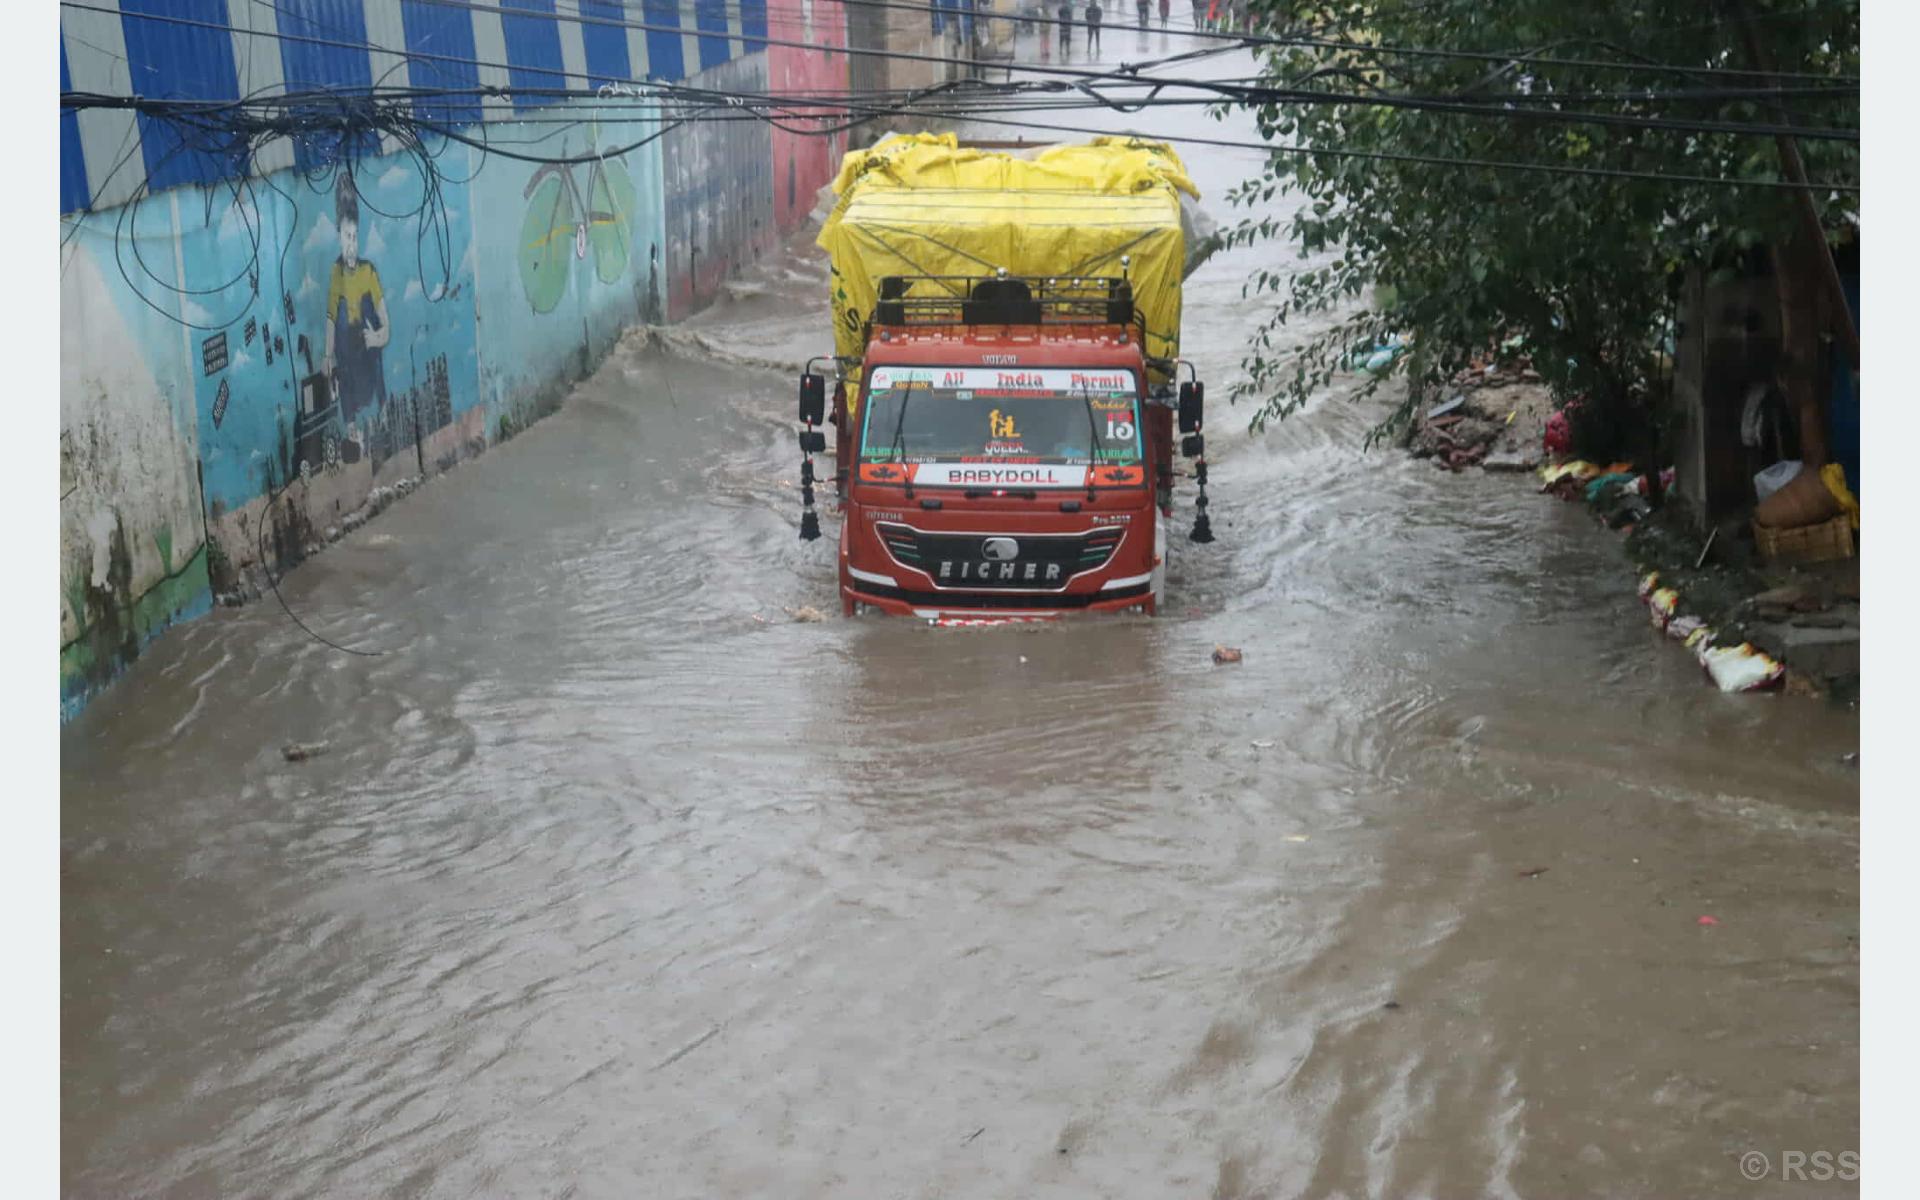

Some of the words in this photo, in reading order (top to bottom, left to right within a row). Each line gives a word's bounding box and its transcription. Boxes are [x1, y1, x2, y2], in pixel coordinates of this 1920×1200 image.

[942, 371, 965, 388] All
[997, 372, 1044, 388] India
[1070, 373, 1125, 390] Permit
[948, 470, 1059, 483] BABYDOLL
[939, 561, 1061, 580] EICHER
